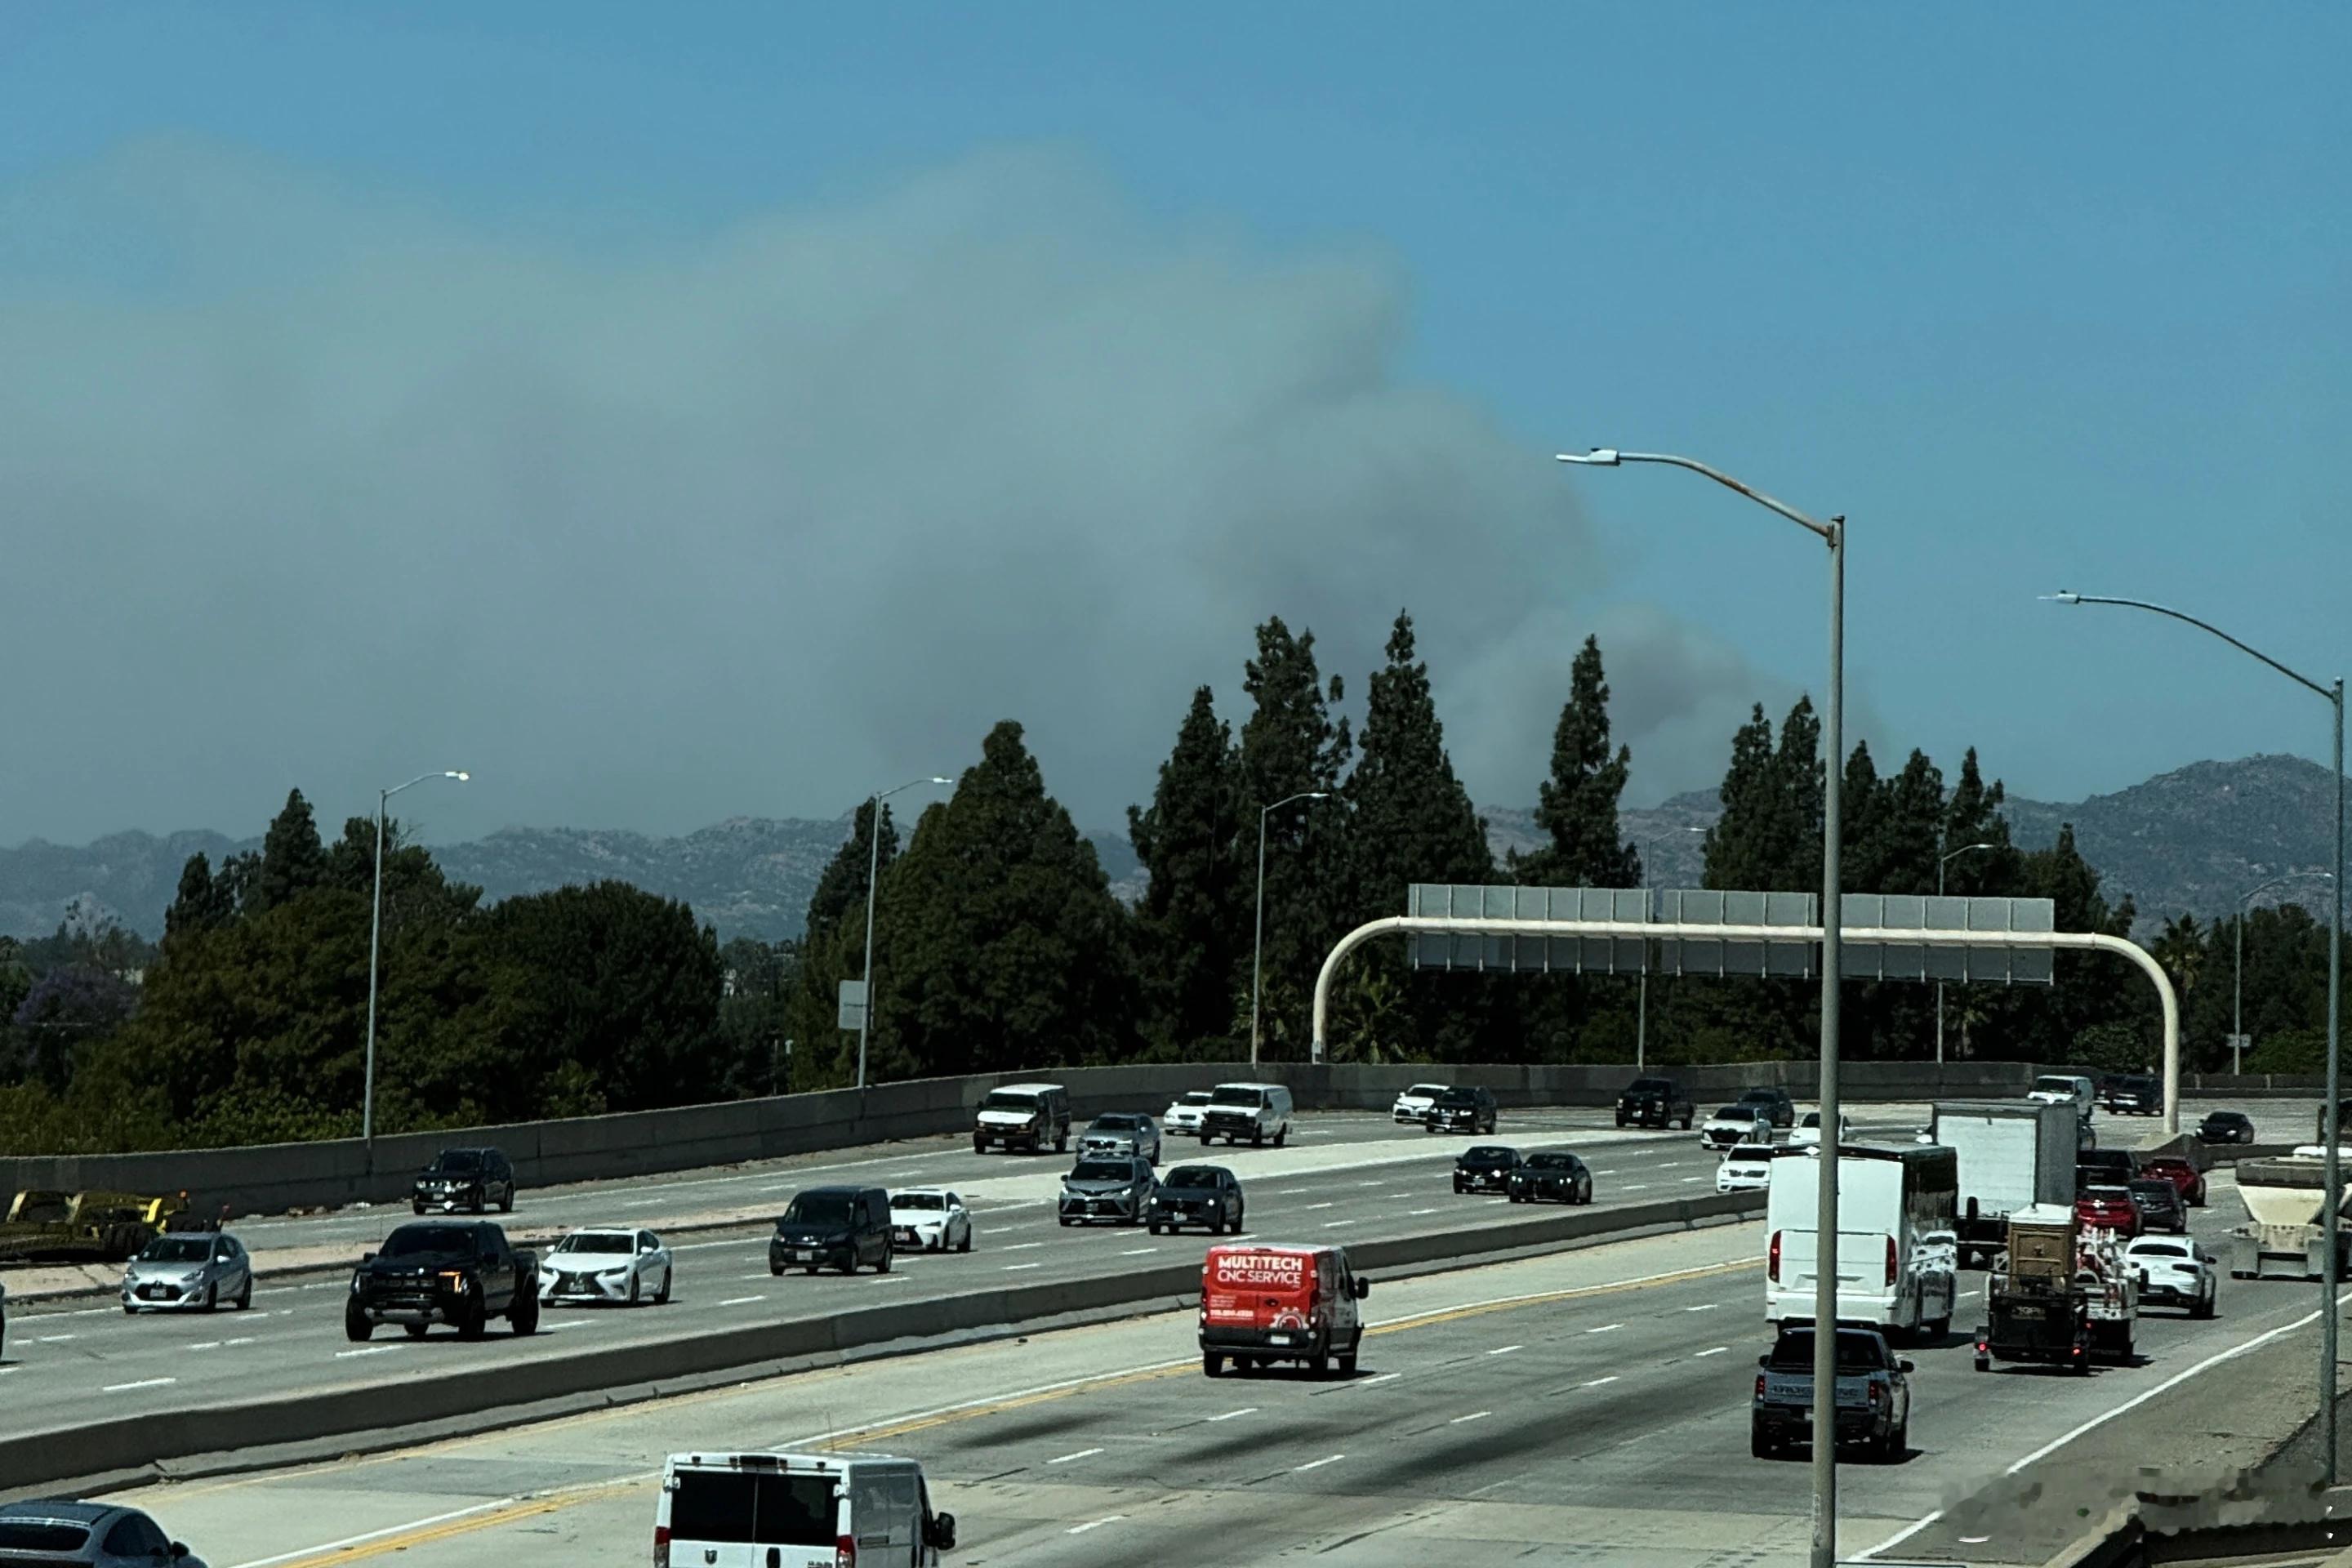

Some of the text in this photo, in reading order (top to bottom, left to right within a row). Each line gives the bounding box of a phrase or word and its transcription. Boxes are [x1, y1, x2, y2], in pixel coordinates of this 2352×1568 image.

[1218, 1255, 1303, 1271] MULTITECH
[1217, 1269, 1302, 1285] CNC SERVICE
